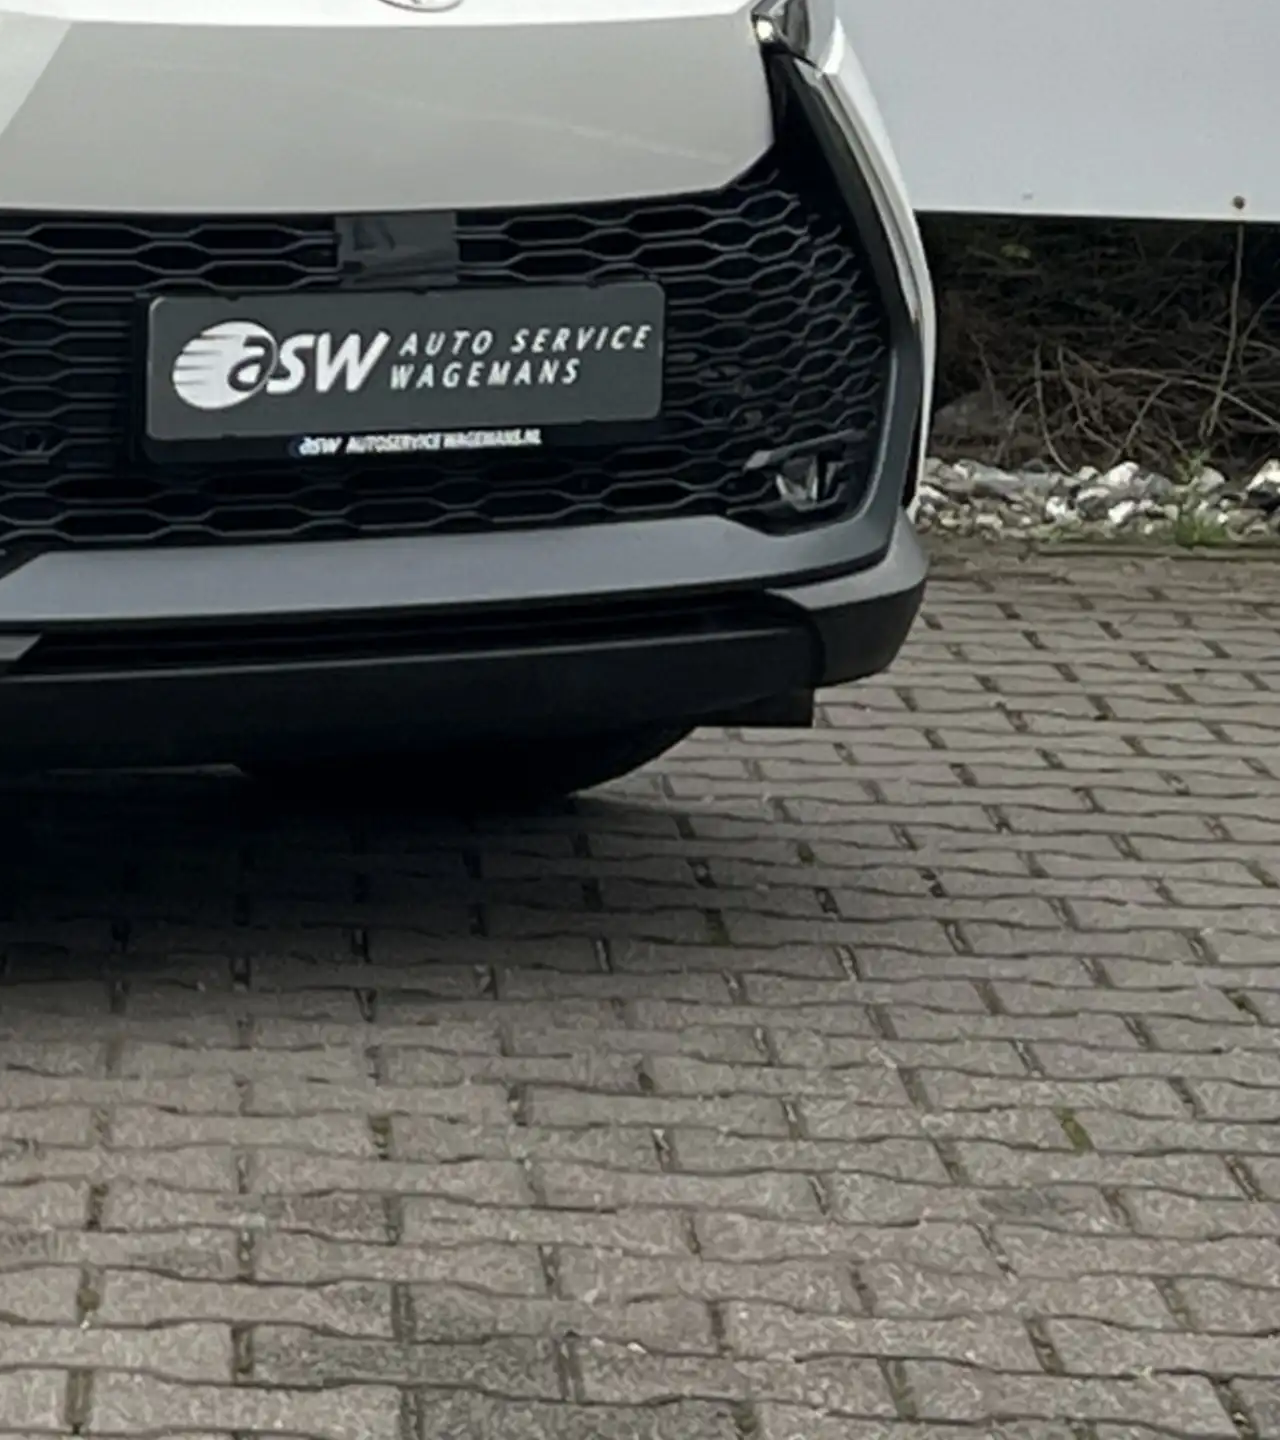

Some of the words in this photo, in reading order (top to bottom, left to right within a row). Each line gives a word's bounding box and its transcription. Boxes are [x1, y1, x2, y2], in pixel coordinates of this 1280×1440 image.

[398, 330, 494, 357] AUTO
[509, 324, 652, 354] SERVICE
[390, 358, 580, 390] WAGEMANS
